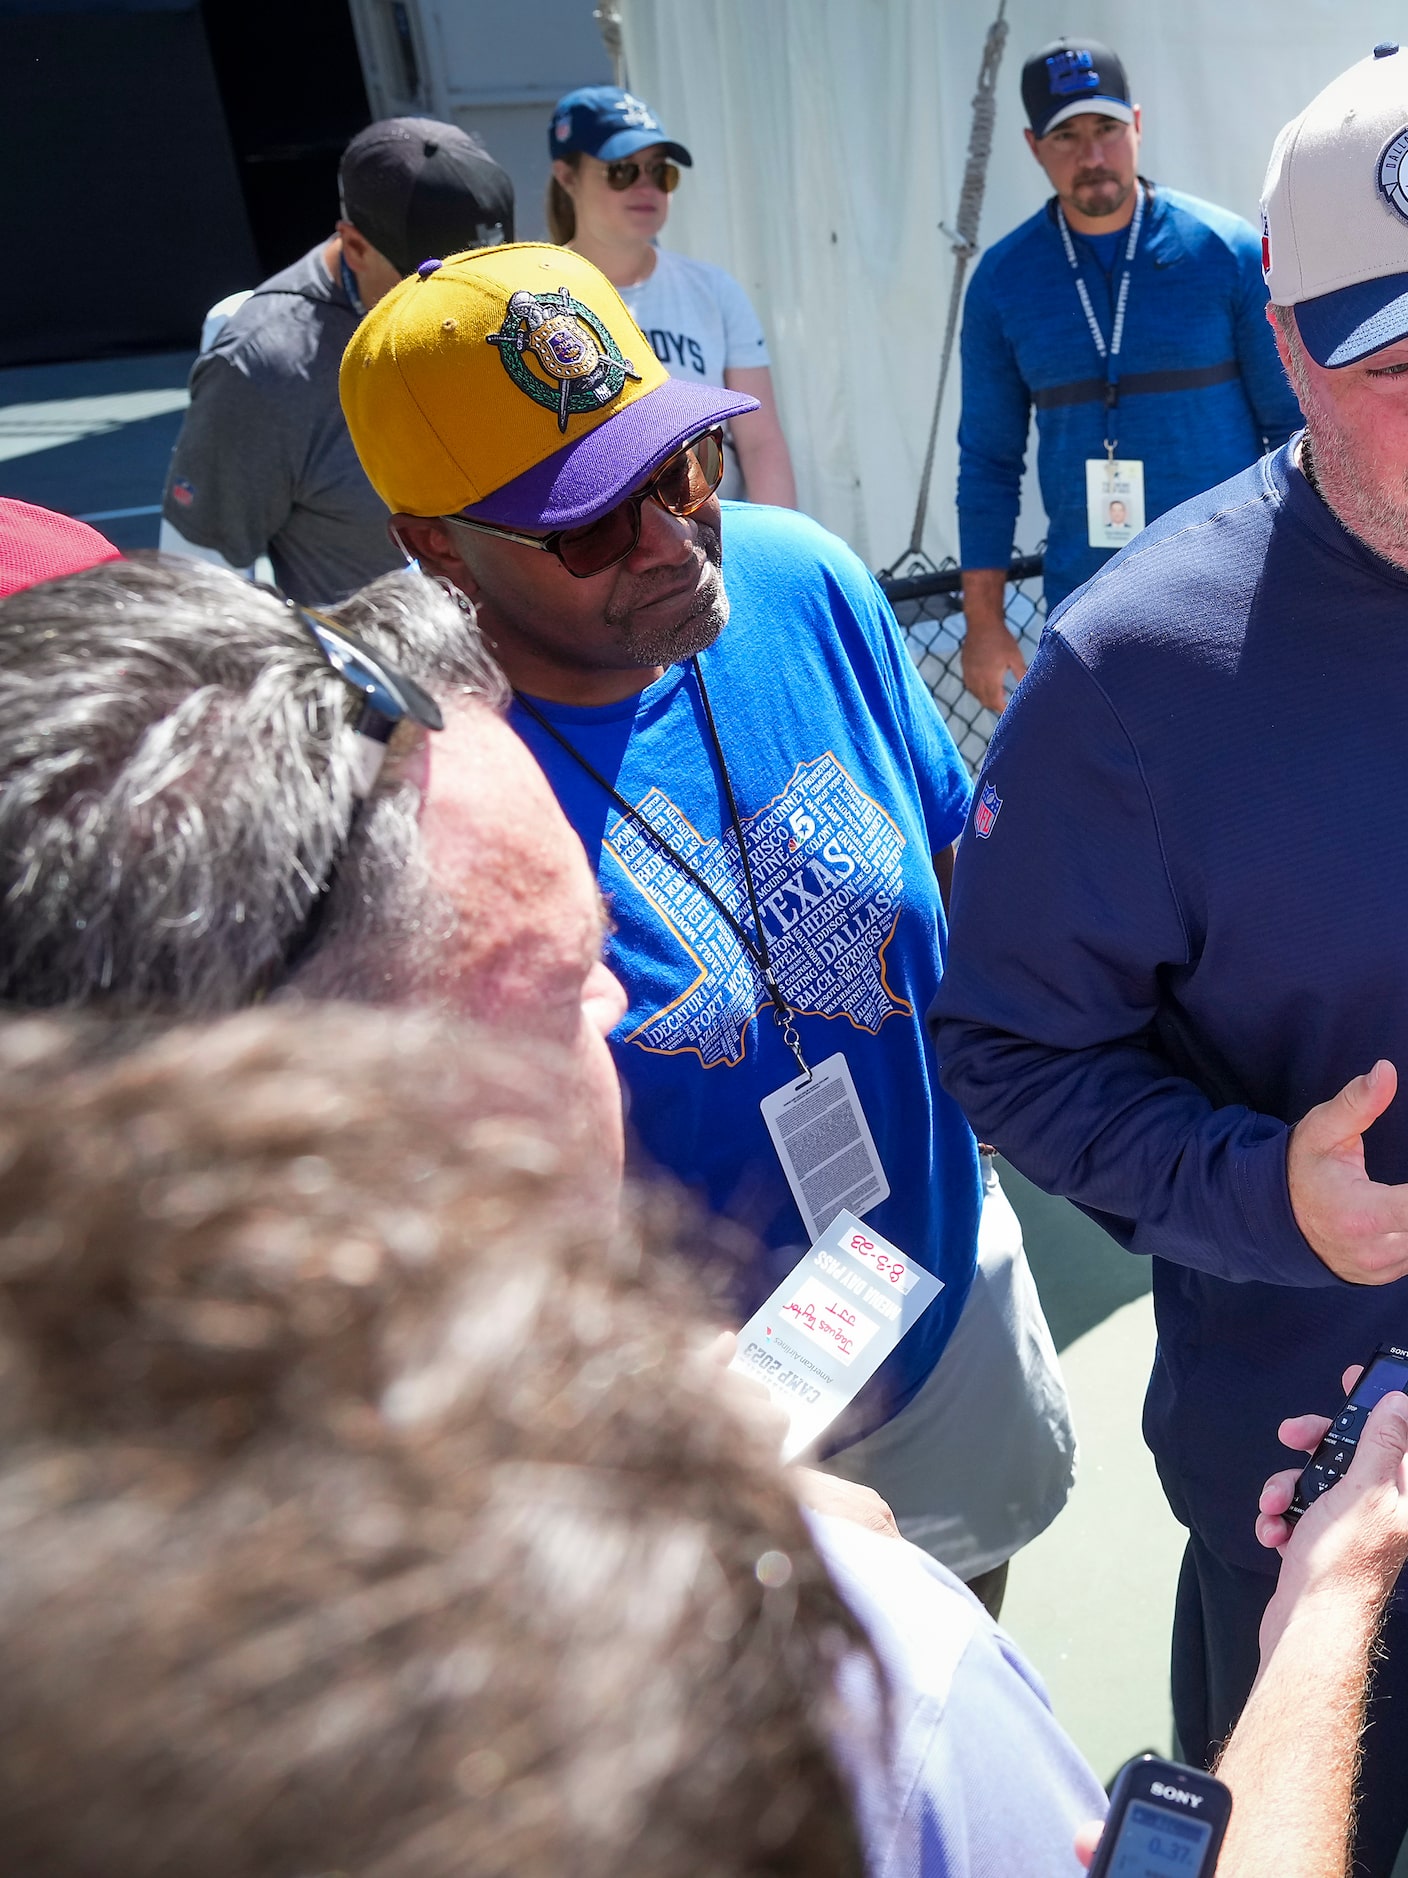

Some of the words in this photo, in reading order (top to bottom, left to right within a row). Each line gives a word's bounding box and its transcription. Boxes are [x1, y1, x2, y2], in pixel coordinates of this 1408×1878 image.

[641, 328, 706, 375] OYS
[814, 787, 829, 805] PILOT
[843, 778, 861, 806] NEVADA
[663, 806, 694, 840] JUSTIN
[741, 818, 754, 835] ELLER
[748, 782, 807, 843] MCKINNEY
[804, 798, 826, 824] PLANO
[821, 802, 843, 827] LAVON
[831, 794, 863, 834] MESQUITE
[859, 803, 876, 827] FATE
[976, 803, 995, 833] NFL
[861, 813, 883, 845] FORNEY
[654, 864, 676, 887] LAKE
[672, 839, 700, 868] DLLAS
[785, 850, 807, 871] THE
[804, 822, 835, 854] COLONY
[836, 830, 871, 873] GARLAND
[880, 845, 902, 877] POETRY
[673, 884, 693, 906] NORTH
[713, 842, 730, 861] HILLS
[716, 868, 745, 901] OUTHLAKE
[756, 868, 787, 899] MOUND
[888, 878, 903, 899] KEMP
[744, 837, 854, 946] TEXAS
[799, 879, 858, 937] HEBRON
[848, 887, 873, 913] HIGHLAND
[646, 883, 698, 942] MOUNTAIN
[687, 897, 709, 924] CITY
[810, 910, 848, 947] ADDISON
[817, 890, 891, 965] DALLAS
[695, 939, 723, 976] EAGLE
[766, 944, 802, 976] OPPELL
[787, 954, 806, 972] BRANCH
[791, 926, 825, 970] CARROLLTON
[842, 946, 875, 982] WILMER
[782, 967, 818, 1001] IRVING
[784, 960, 811, 986] COLINAS
[794, 969, 837, 1010] BALCH
[833, 925, 881, 975] SPRINGS
[814, 983, 840, 1009] DESOTO
[823, 976, 862, 1014] WAXAHACHIE
[841, 983, 866, 1011] ENNIS
[862, 962, 893, 1016] PALMER
[649, 991, 705, 1043] DECATUR
[690, 990, 725, 1036] FORT
[856, 996, 873, 1019] ALMA
[863, 1004, 876, 1025] RICE
[697, 1019, 719, 1048] AZLE
[812, 1249, 847, 1280] PASS
[851, 1234, 904, 1282] 8-3-23
[838, 1269, 868, 1295] DAY
[861, 1285, 903, 1321] MEDIA
[772, 1336, 802, 1361] Airlines
[818, 1319, 852, 1354] Jaques
[742, 1340, 783, 1376] 2023
[797, 1355, 834, 1385] American
[777, 1366, 822, 1405] CAMP
[1150, 1782, 1204, 1809] SONY
